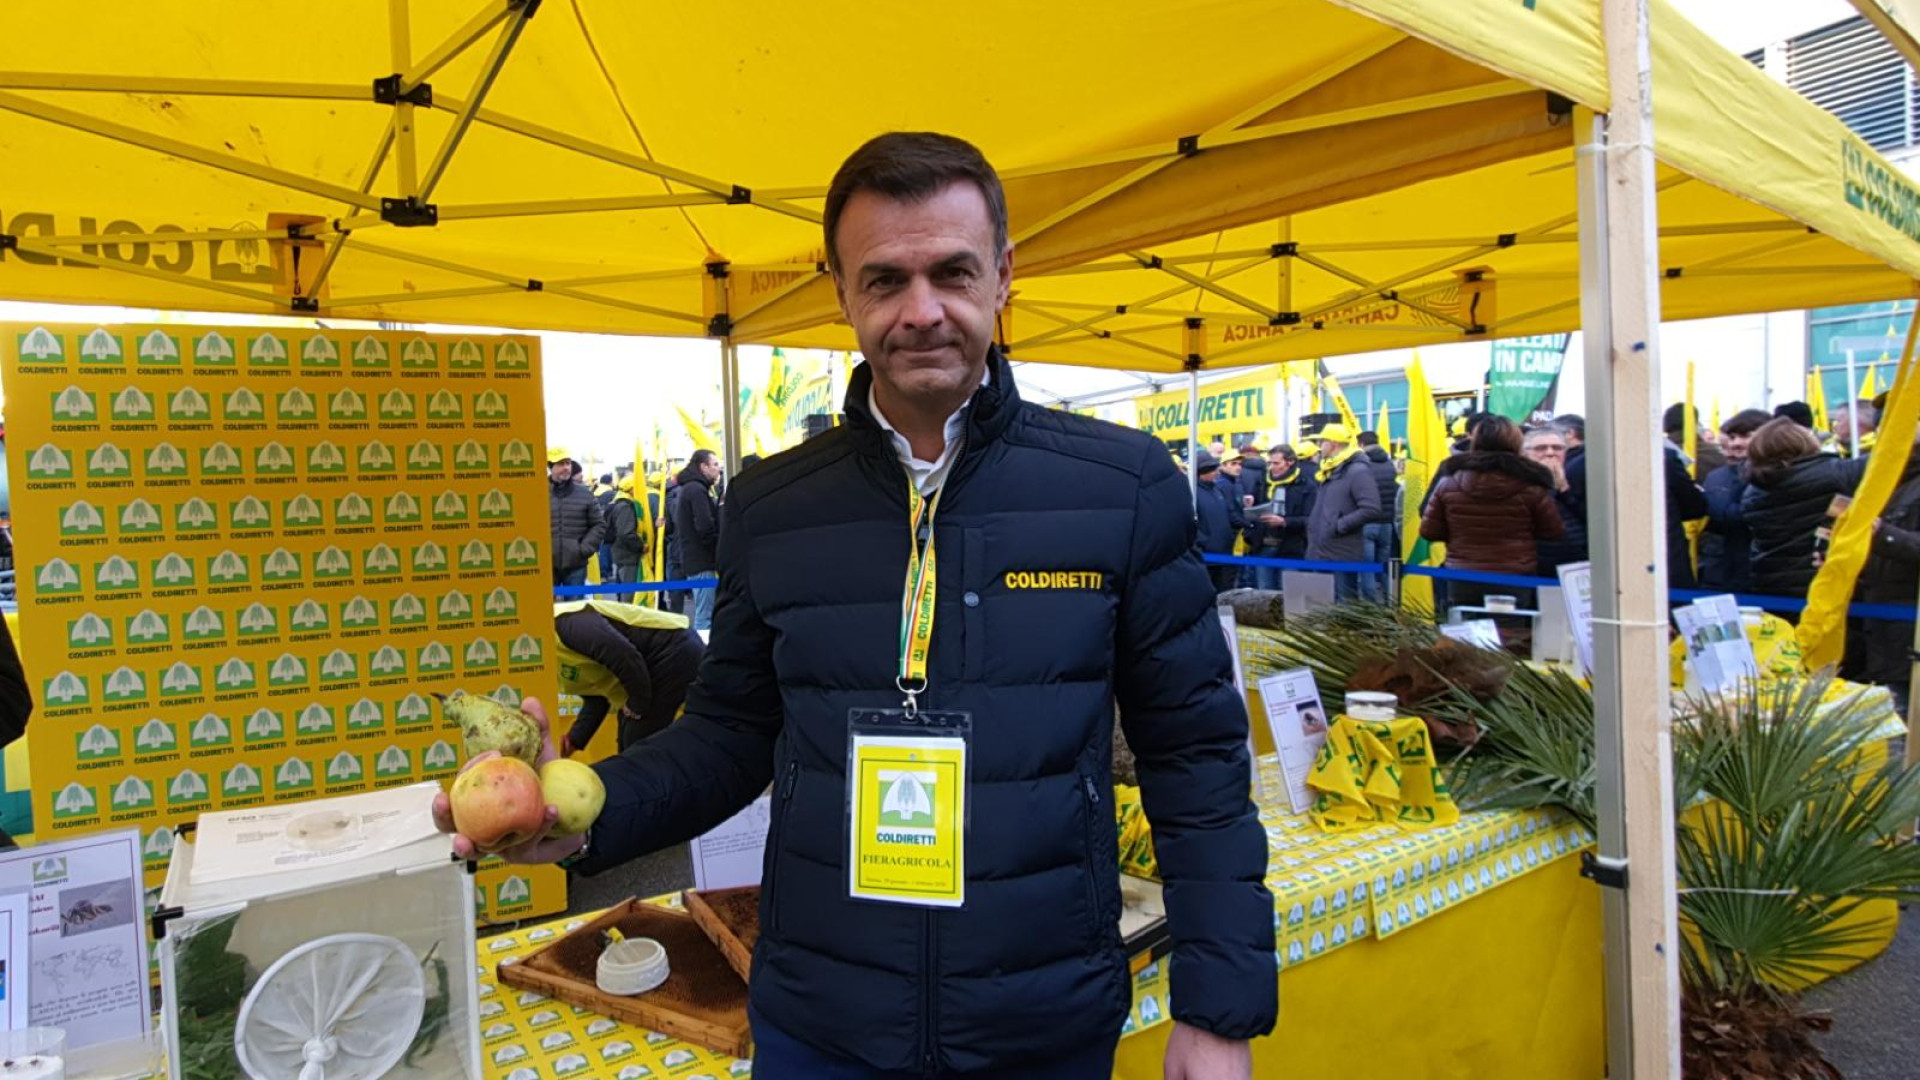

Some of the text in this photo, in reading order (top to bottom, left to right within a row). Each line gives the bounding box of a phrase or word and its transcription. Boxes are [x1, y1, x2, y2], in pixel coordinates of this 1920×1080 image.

[1005, 571, 1102, 590] COLDIRETTI
[917, 581, 934, 640] COLDIRETTI
[876, 832, 937, 846] COLDIRETTI
[863, 854, 951, 869] FIERAGRICOLA
